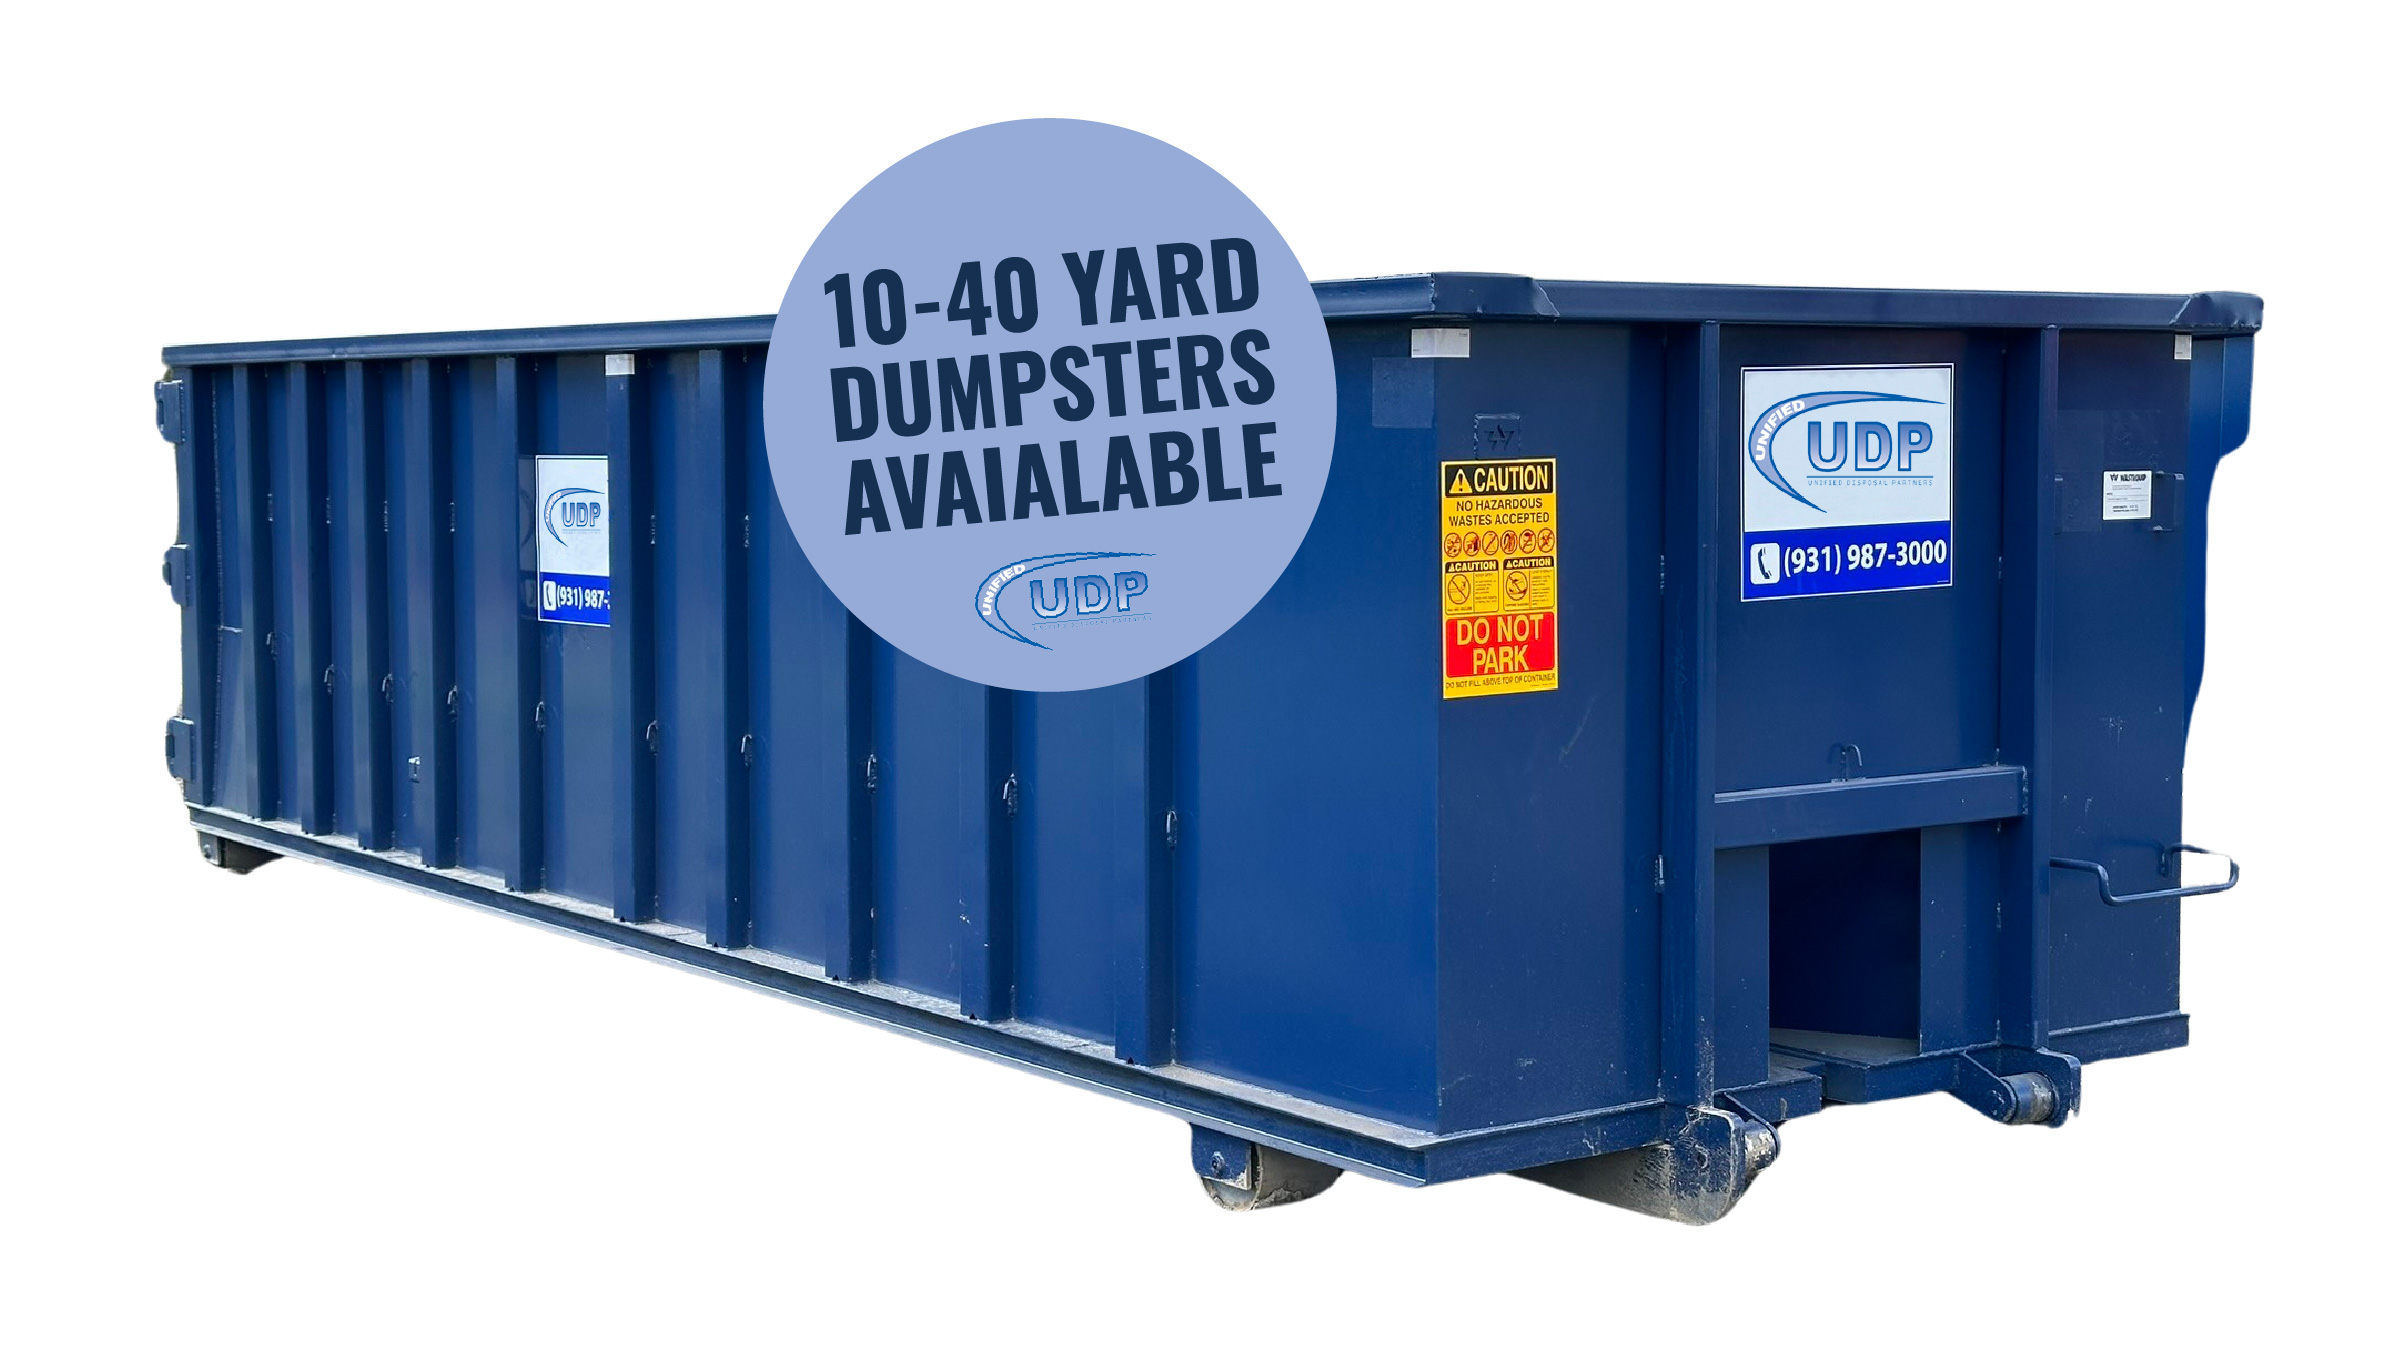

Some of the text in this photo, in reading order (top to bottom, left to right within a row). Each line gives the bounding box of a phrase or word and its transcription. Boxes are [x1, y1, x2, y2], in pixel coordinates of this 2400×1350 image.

[1755, 399, 1806, 461] UNIFIED
[1807, 421, 1934, 473] UDP
[1474, 464, 1548, 493] CAUTION
[1807, 479, 1933, 487] UNIFIED DISPOSAL PARTNERS
[562, 502, 601, 527] UDP
[1456, 497, 1543, 512] NO HAZARDOUS
[1448, 512, 1550, 526] WASTES ACCEPTED
[1455, 560, 1497, 572] CAUTION
[1512, 557, 1551, 568] CAUTION
[1784, 539, 1947, 577] (931) 987-3000
[557, 585, 583, 610] (931)
[1456, 613, 1544, 646] DO NOT
[1472, 644, 1530, 675] PARK
